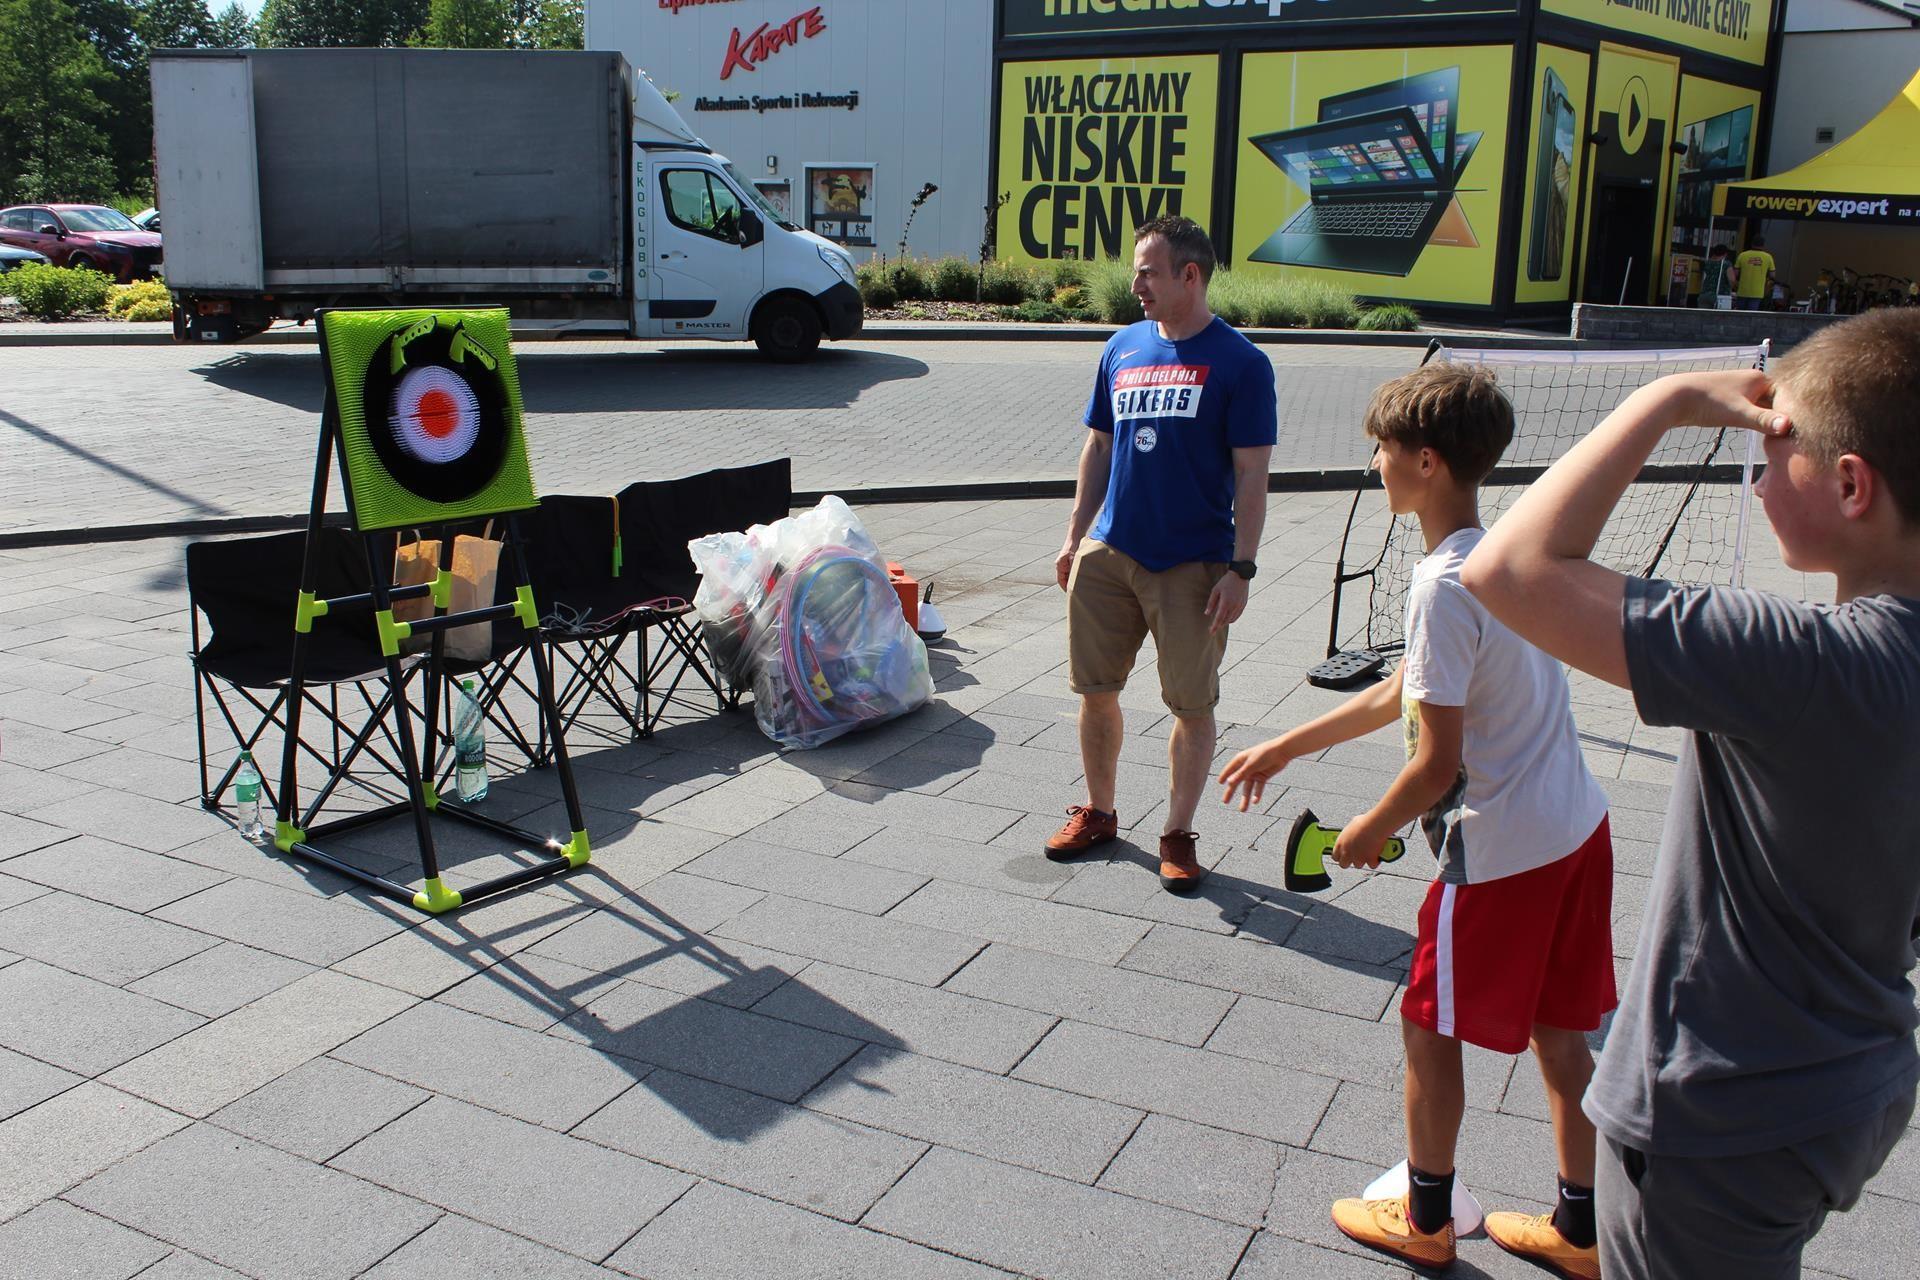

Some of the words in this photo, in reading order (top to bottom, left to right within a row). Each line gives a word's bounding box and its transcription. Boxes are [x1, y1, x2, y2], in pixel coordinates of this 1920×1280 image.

[1713, 0, 1751, 41] CENY!
[720, 6, 827, 80] KARATE
[694, 96, 750, 112] Akademia
[751, 94, 794, 113] Sportu
[795, 93, 800, 108] i
[801, 90, 859, 110] Rekreacji
[1024, 72, 1192, 117] WŁĄCZAMY
[1022, 115, 1188, 185] NISKIE
[1122, 369, 1197, 385] PHILADELPHIA
[1117, 388, 1192, 414] SIXERS
